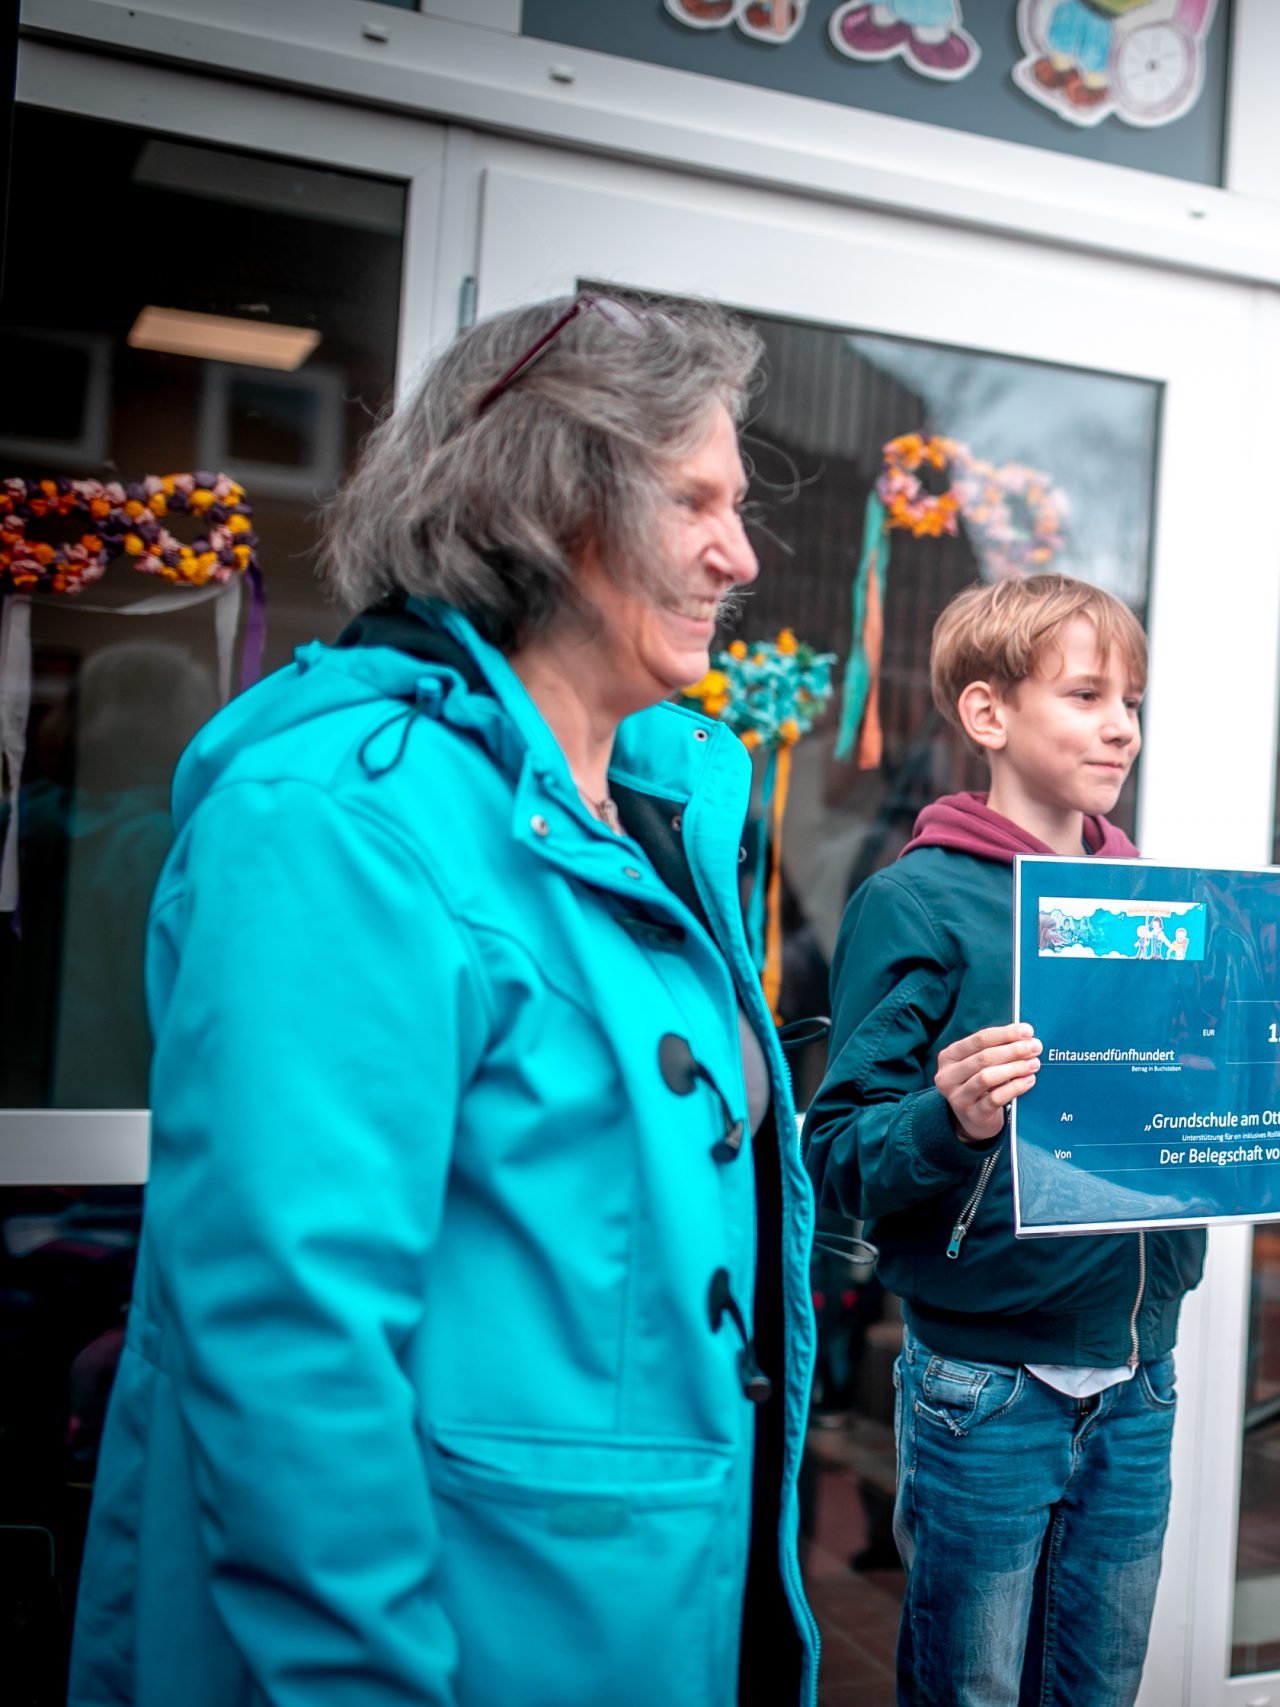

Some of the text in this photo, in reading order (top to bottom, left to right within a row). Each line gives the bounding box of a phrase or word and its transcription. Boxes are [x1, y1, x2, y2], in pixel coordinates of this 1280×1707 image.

[1203, 1029, 1215, 1037] EUR
[1048, 1049, 1175, 1061] Eintausendfünfhundert
[1131, 1065, 1148, 1073] Betrag
[1060, 1112, 1073, 1121] An
[1240, 1115, 1260, 1126] am
[1182, 1134, 1224, 1142] Unterstützung
[1224, 1132, 1233, 1140] für
[1054, 1149, 1072, 1159] Von
[1160, 1149, 1185, 1164] Der
[1189, 1145, 1263, 1165] Belegschaft
